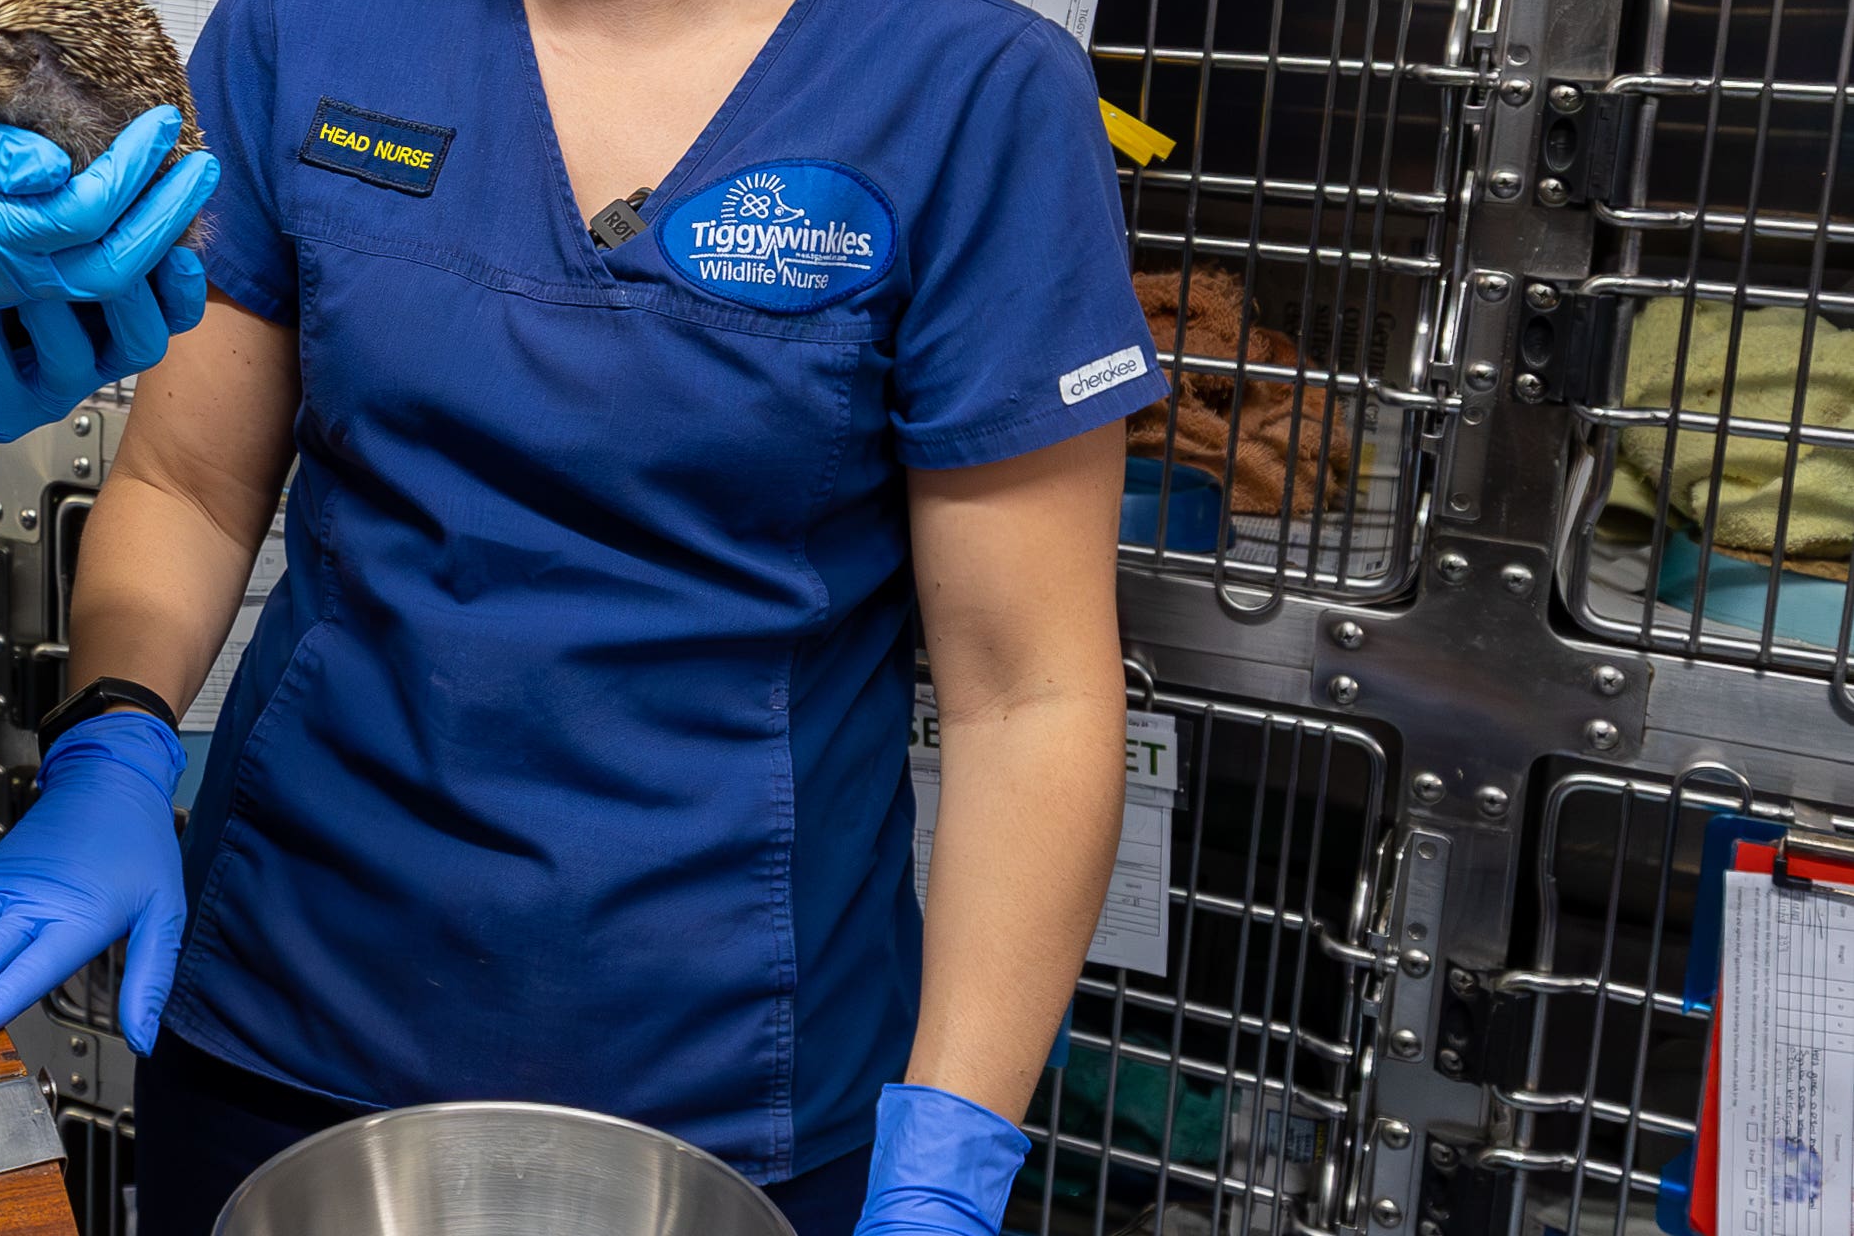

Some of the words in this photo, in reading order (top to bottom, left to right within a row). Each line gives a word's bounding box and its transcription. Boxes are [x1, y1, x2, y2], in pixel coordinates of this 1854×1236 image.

[319, 123, 371, 152] HEAD
[373, 140, 435, 169] NURSE
[691, 219, 872, 257] Tiggywinkles
[699, 260, 777, 285] Wildlife
[782, 265, 830, 290] Nurse
[1071, 360, 1137, 396] cherokee
